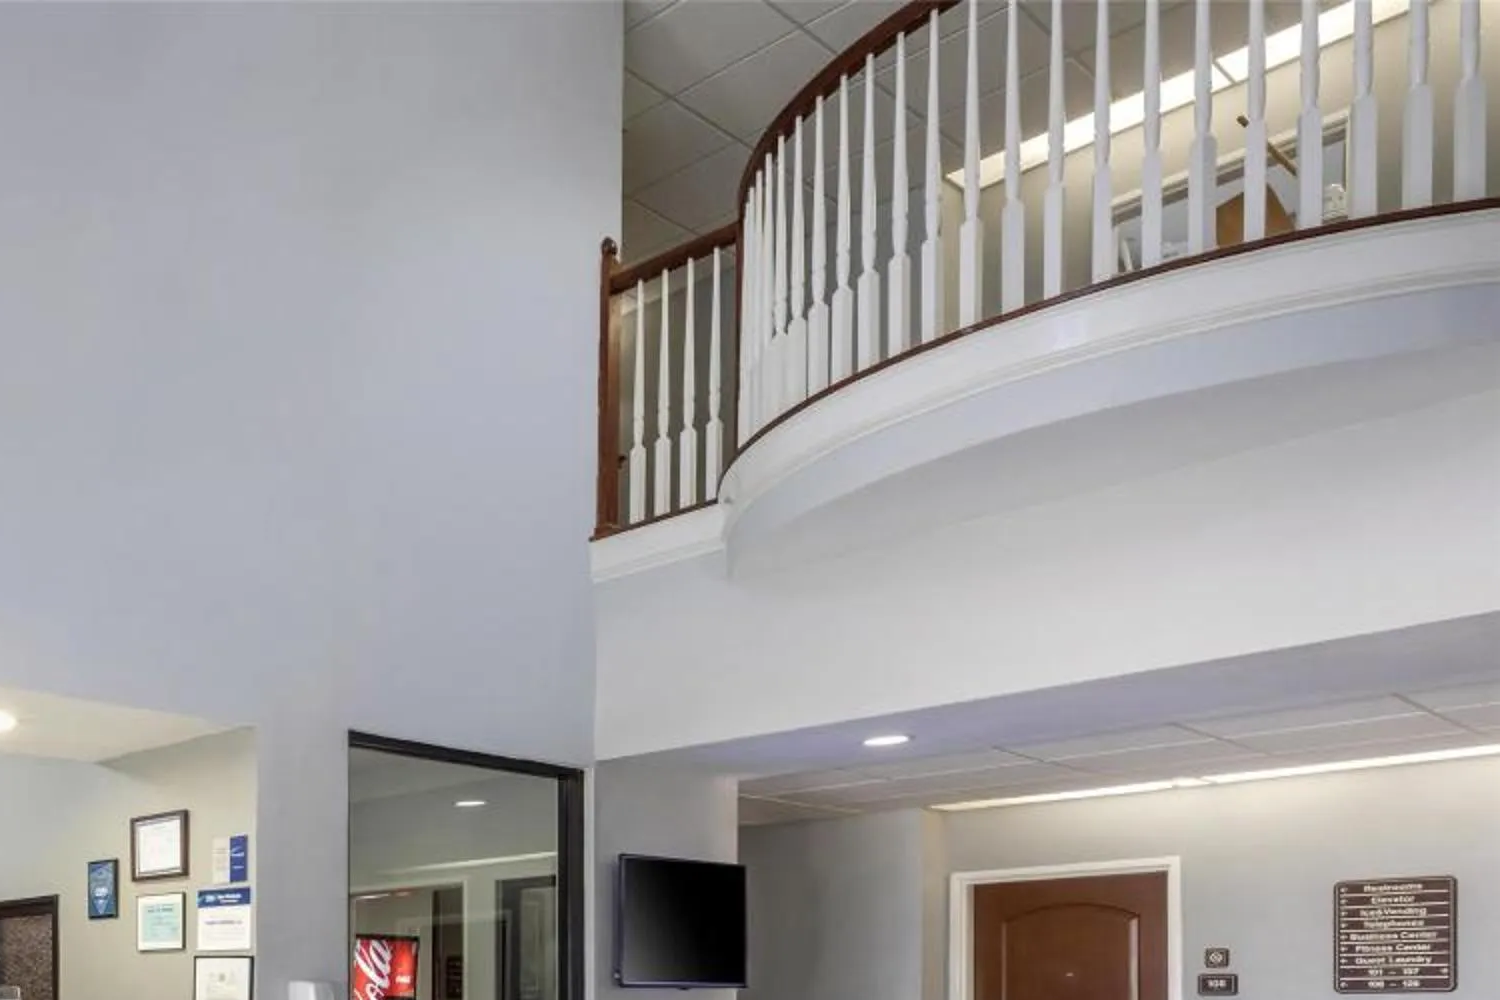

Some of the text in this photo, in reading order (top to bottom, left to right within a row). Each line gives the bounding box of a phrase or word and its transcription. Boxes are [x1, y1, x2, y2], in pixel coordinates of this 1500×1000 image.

[1371, 895, 1415, 905] Elevator
[1350, 931, 1438, 941] Business Center
[1355, 943, 1431, 953] Fitness Center
[1388, 955, 1432, 965] Laundry
